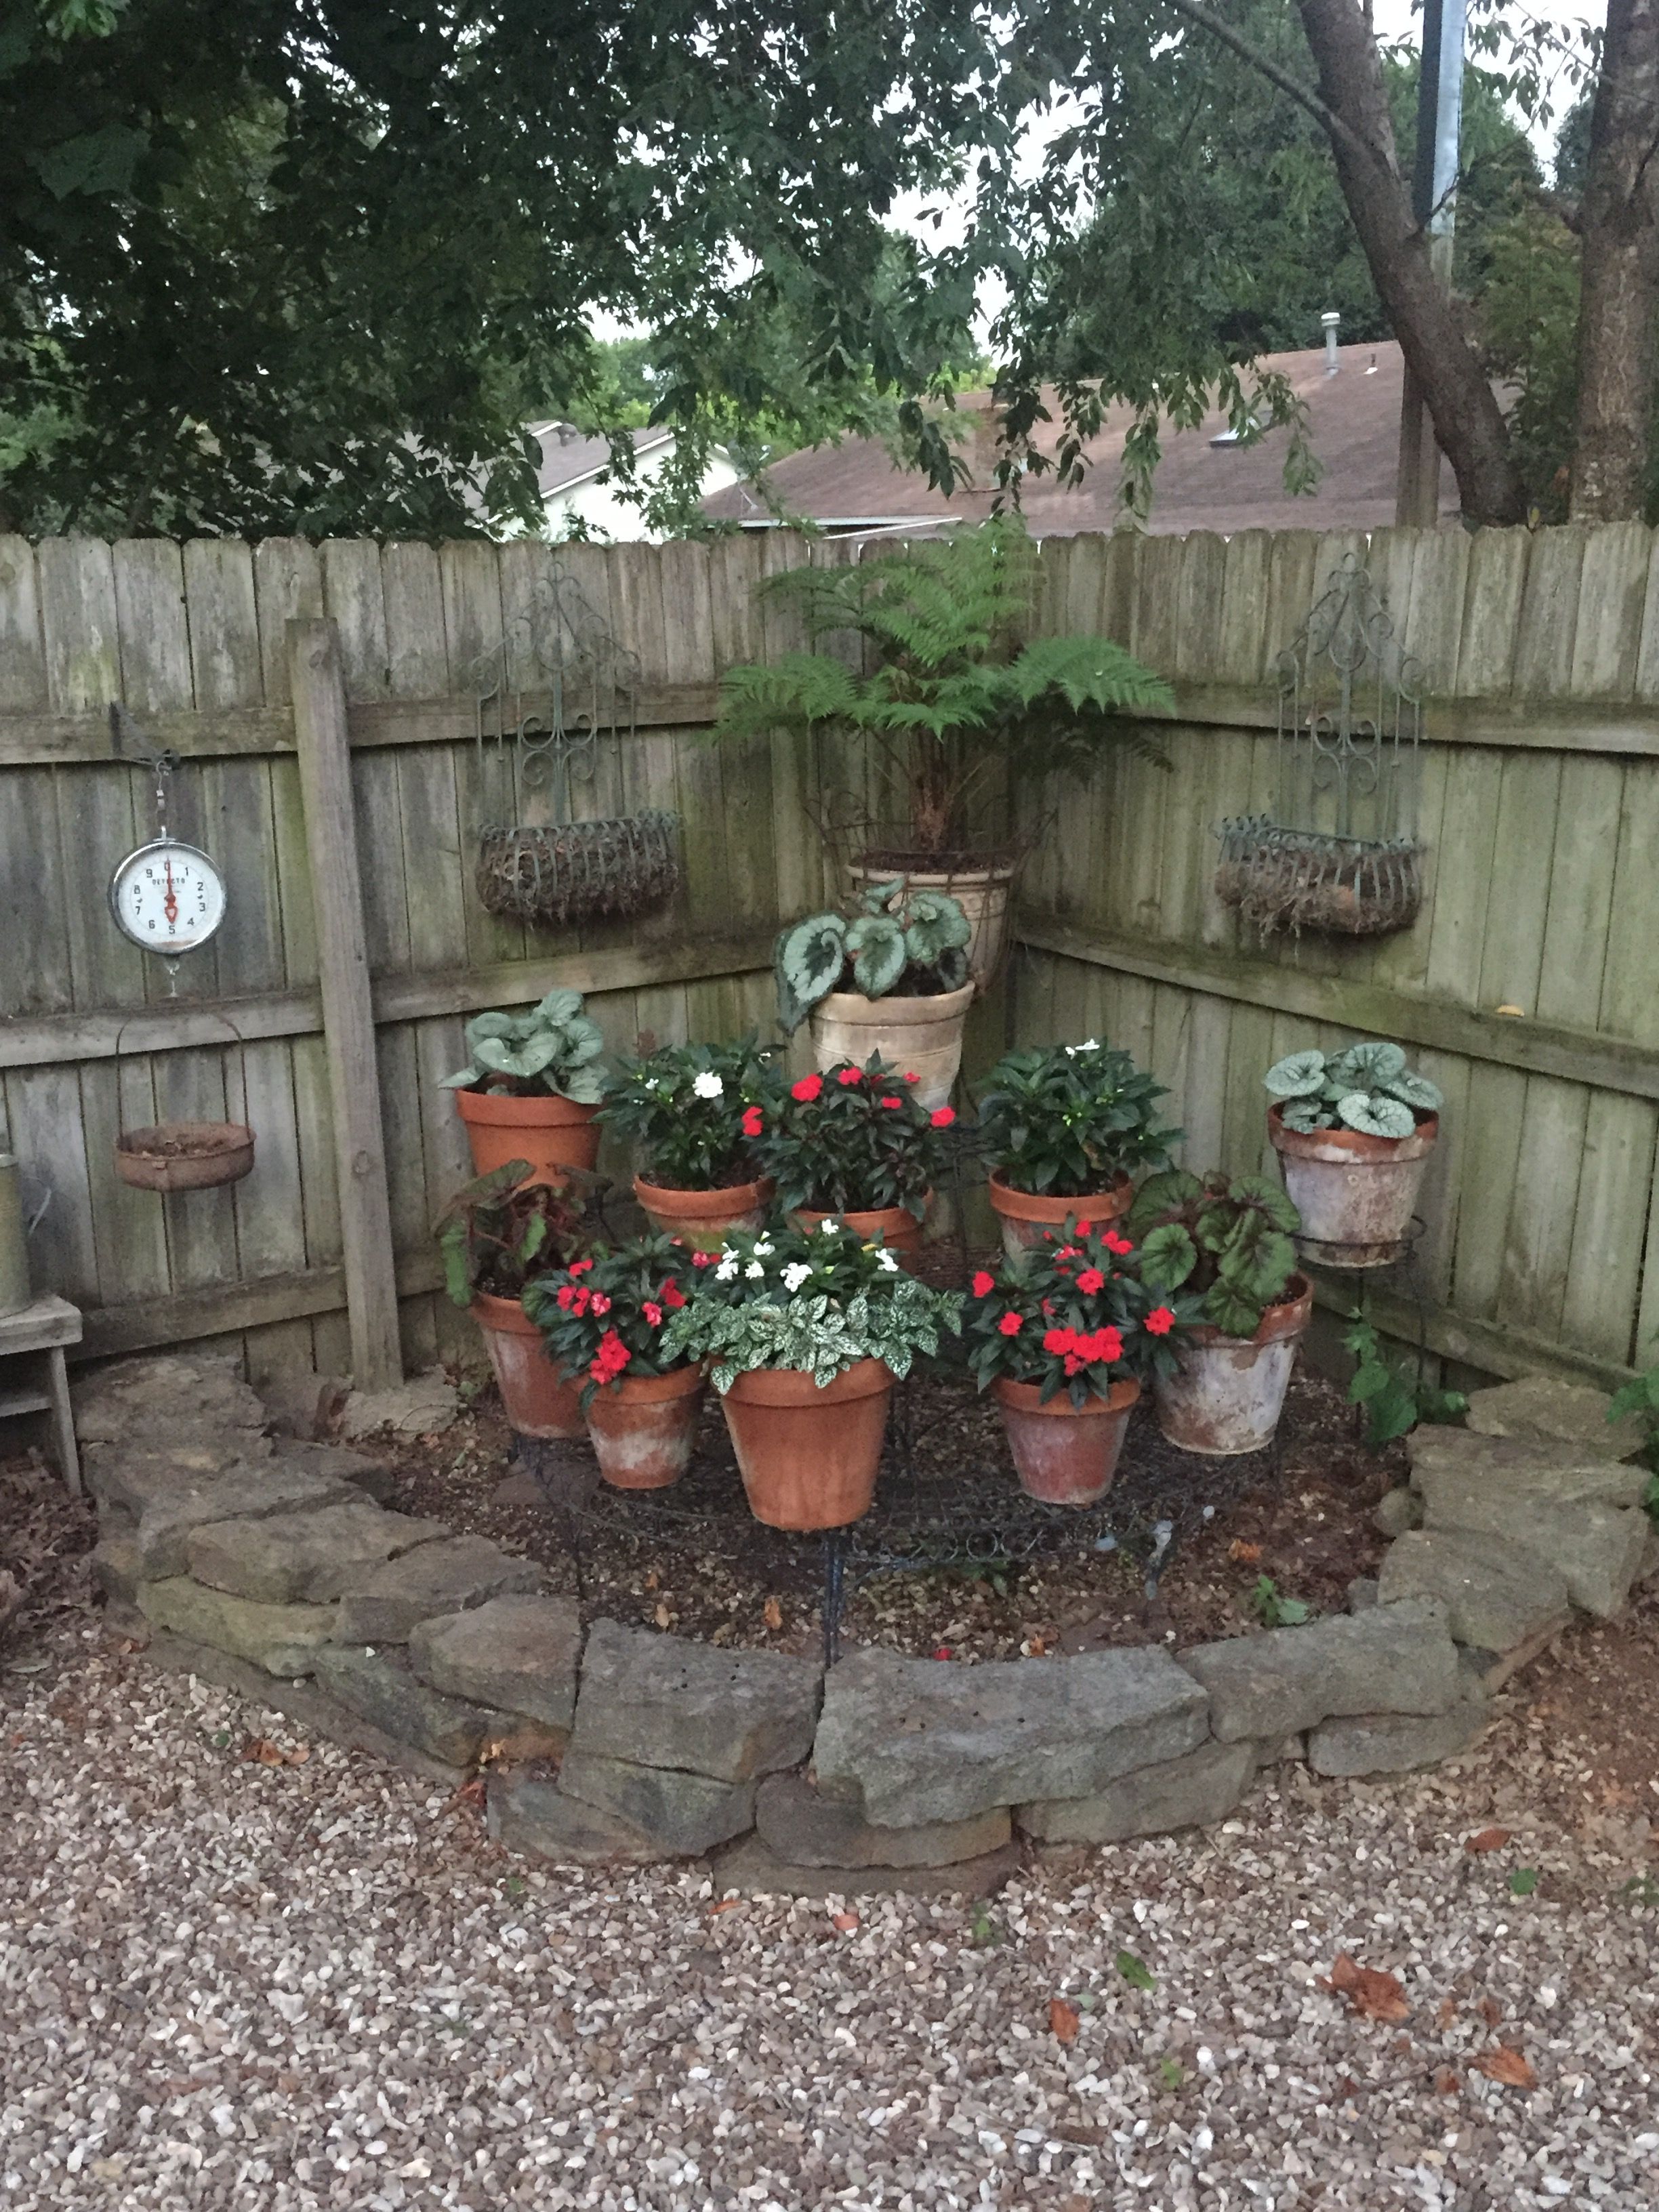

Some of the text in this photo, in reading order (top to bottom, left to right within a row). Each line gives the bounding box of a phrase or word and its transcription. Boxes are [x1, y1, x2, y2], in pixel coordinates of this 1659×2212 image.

[146, 869, 153, 878] 9
[185, 867, 189, 876] 1
[134, 885, 140, 894] 8
[197, 882, 204, 891] 2
[135, 906, 141, 915] 7
[199, 903, 205, 912] 3
[148, 920, 155, 929] 6
[187, 918, 194, 926] 4
[169, 925, 176, 935] 5
